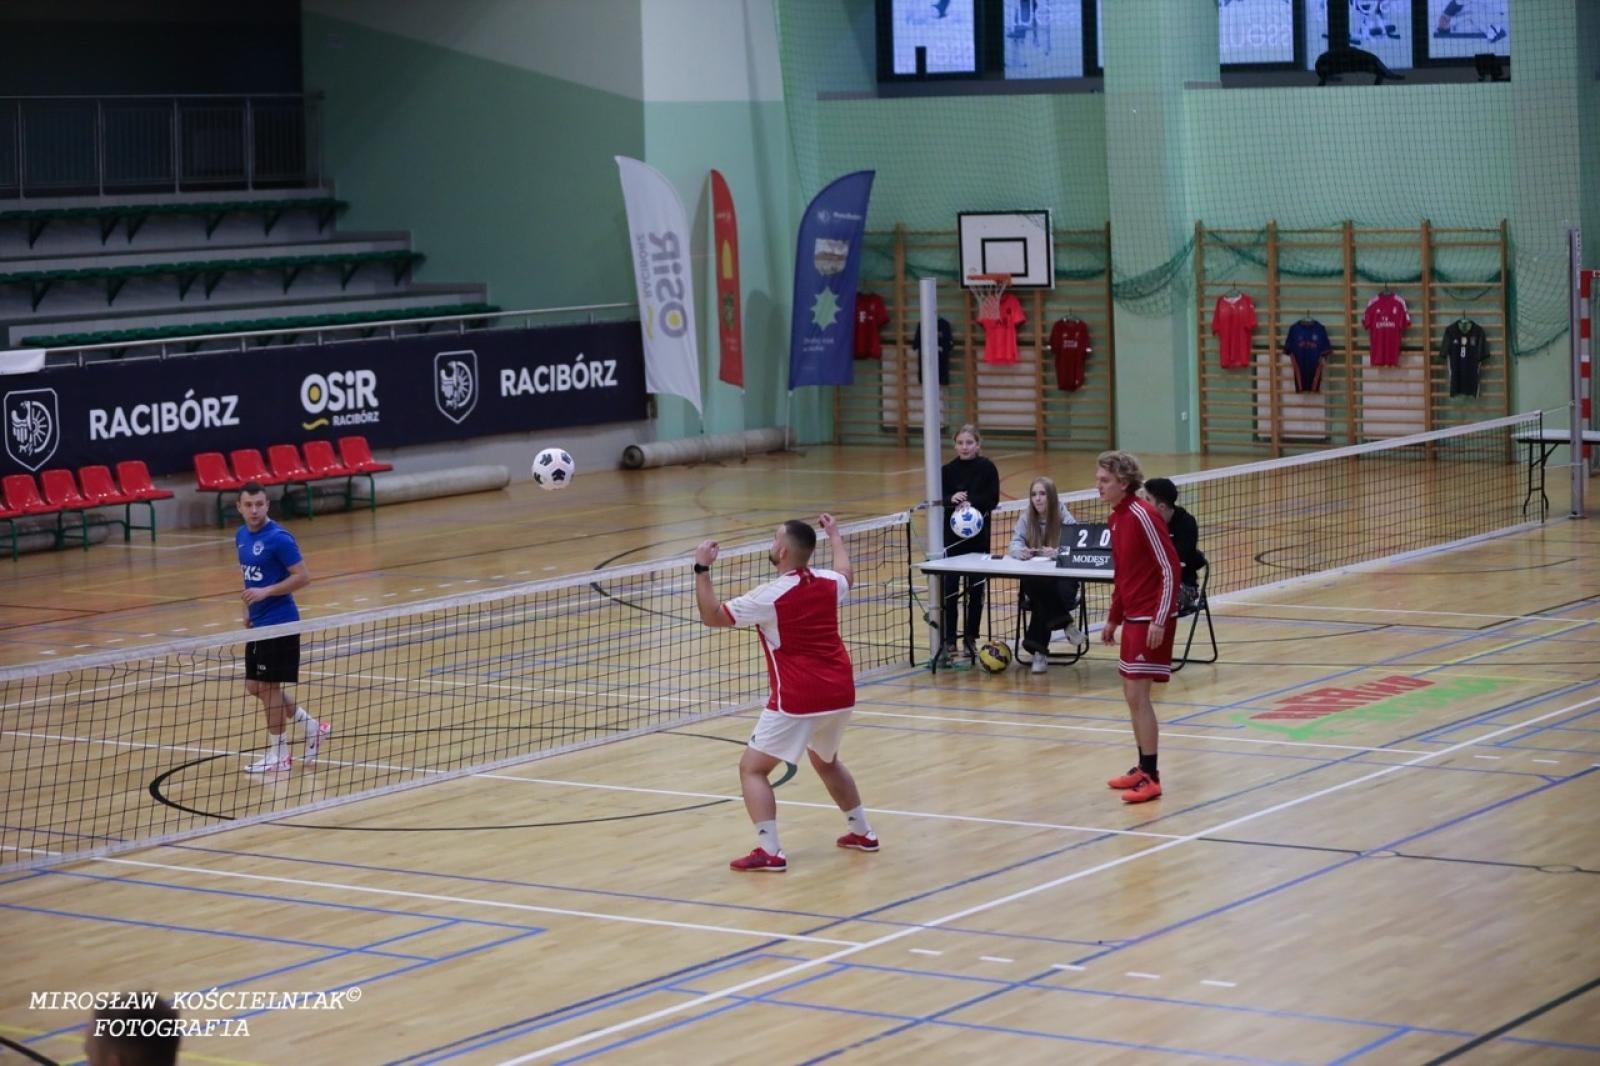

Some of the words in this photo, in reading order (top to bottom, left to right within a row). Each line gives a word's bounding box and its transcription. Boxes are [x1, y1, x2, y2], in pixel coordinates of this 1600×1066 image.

[500, 353, 618, 397] RACIBÓRZ
[300, 369, 379, 414] OSiR
[89, 388, 240, 440] RACIBÓRZ
[332, 409, 379, 426] RACIBÓRZ
[1077, 529, 1088, 547] 2
[1100, 529, 1111, 547] 0
[1072, 554, 1111, 563] MODEST
